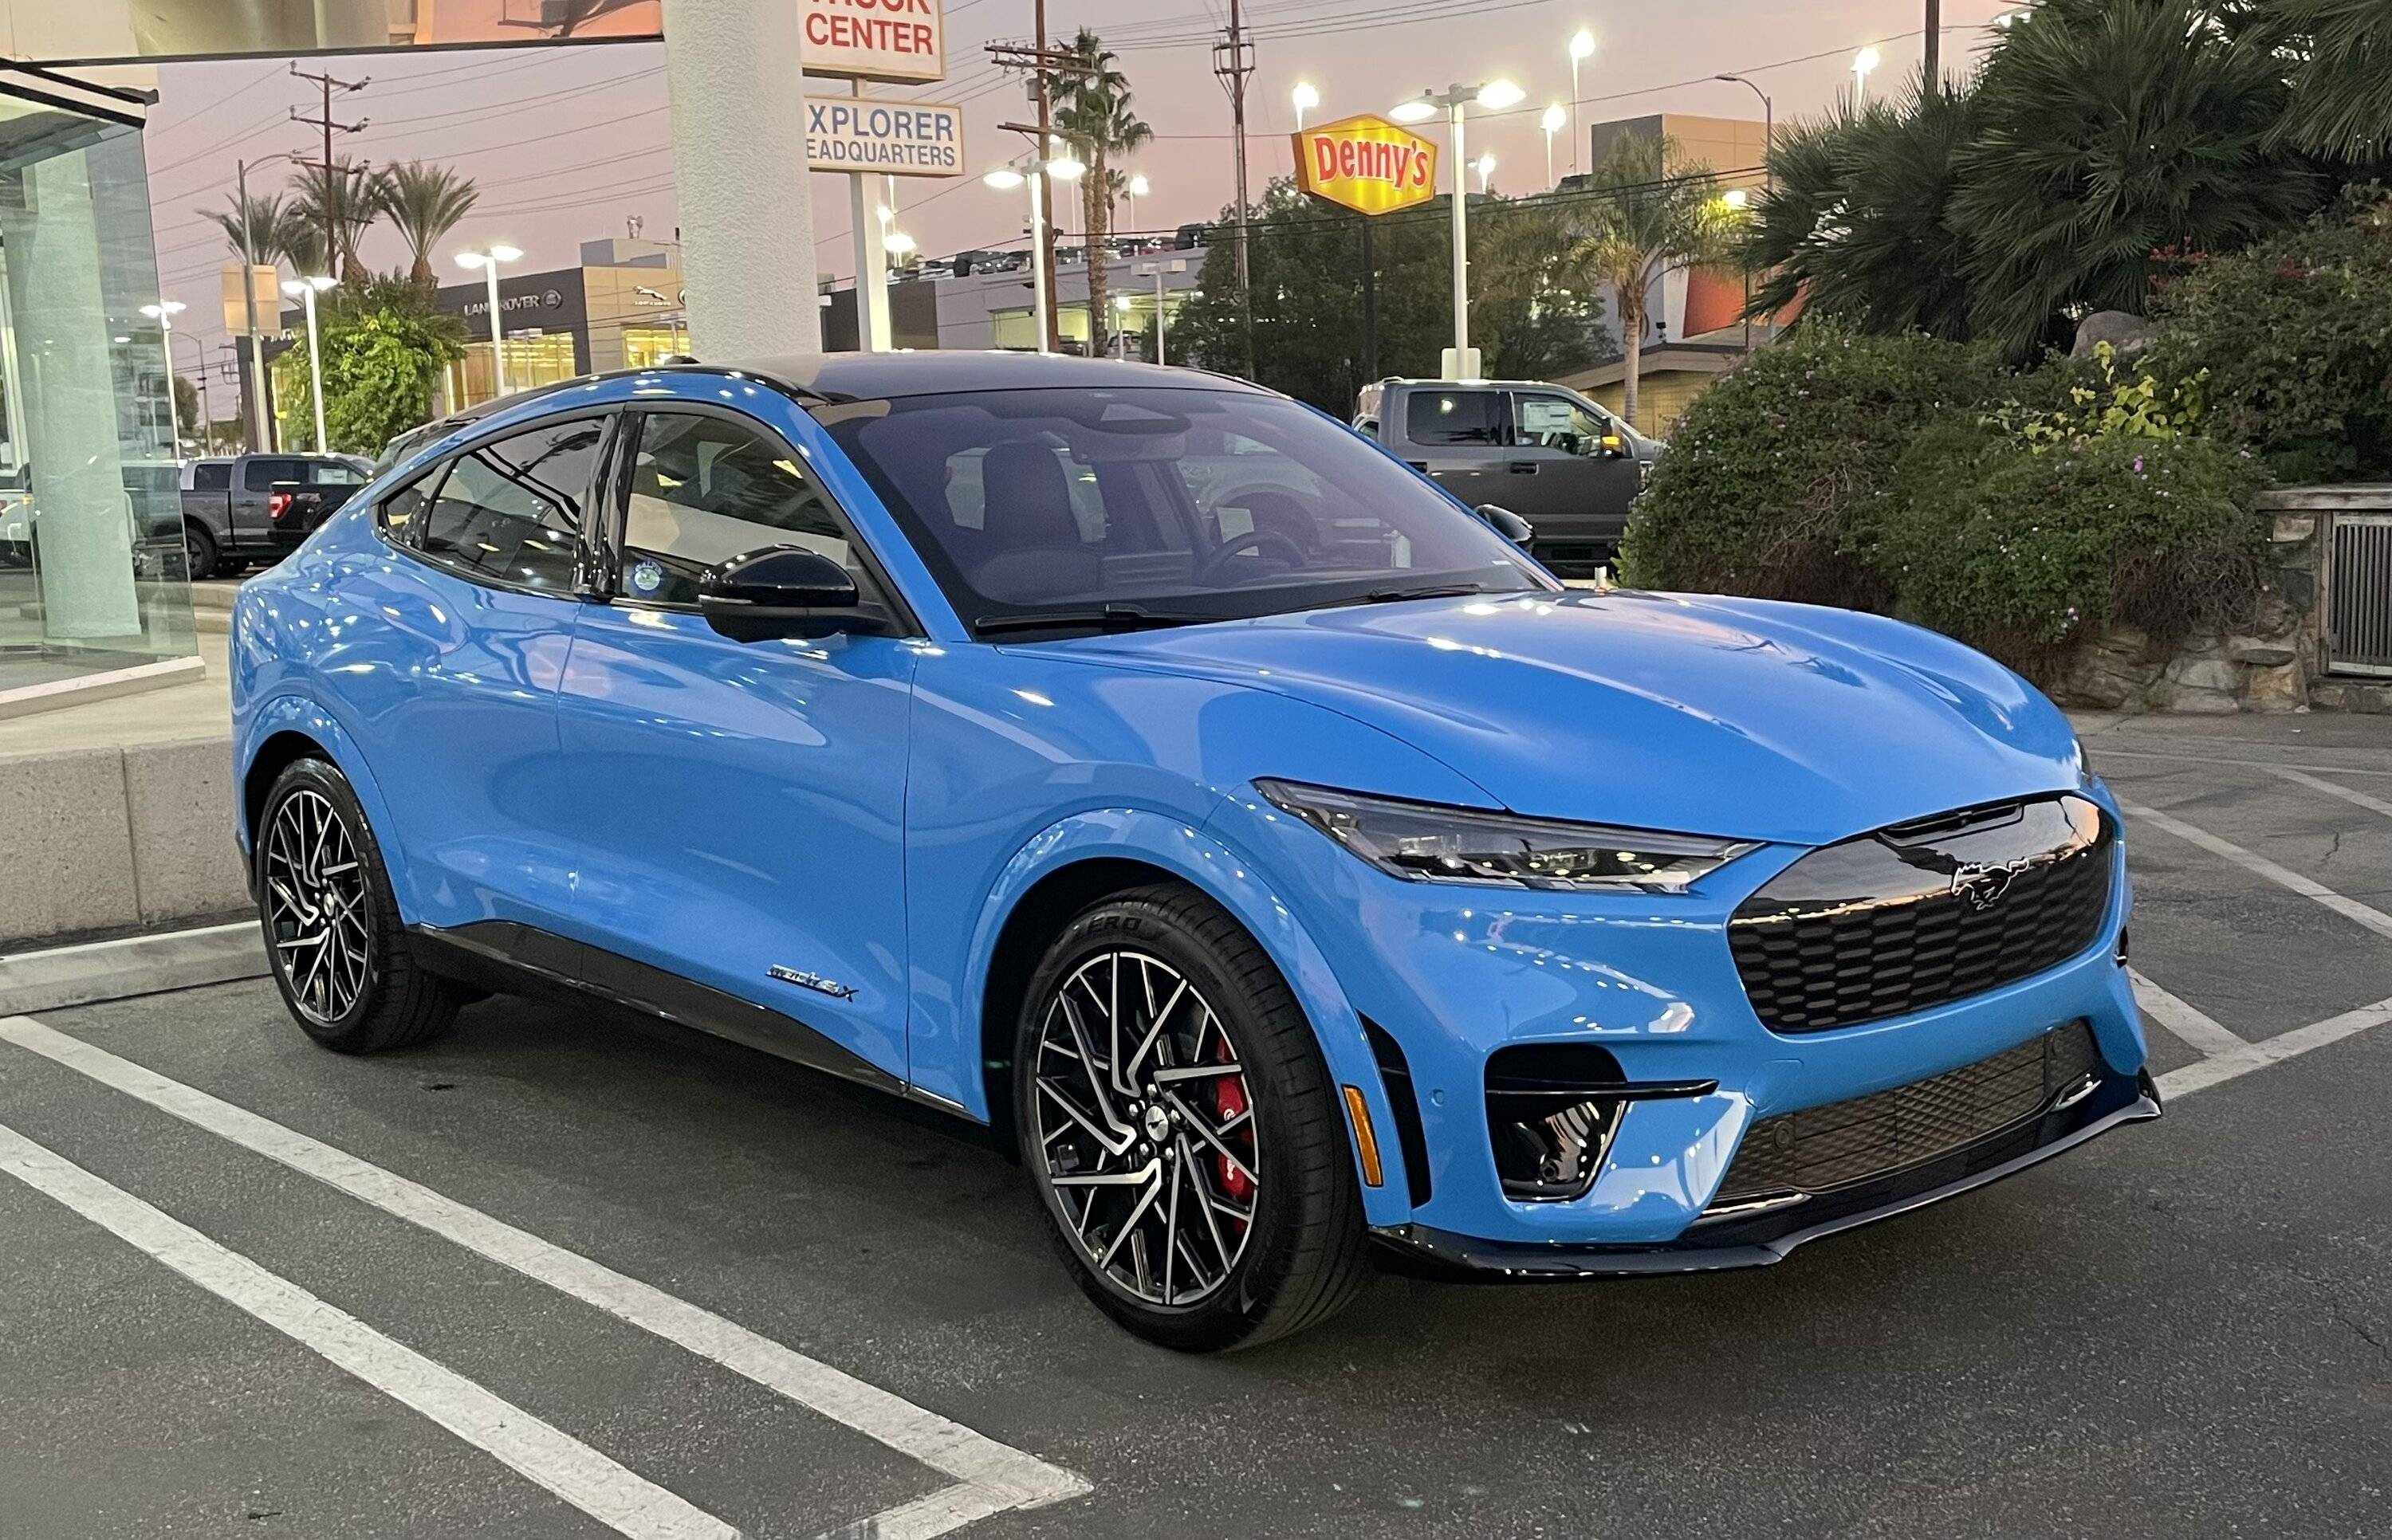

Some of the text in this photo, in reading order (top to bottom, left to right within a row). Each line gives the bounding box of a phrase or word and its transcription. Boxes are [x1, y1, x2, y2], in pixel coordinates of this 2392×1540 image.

[806, 12, 933, 55] CENTER
[808, 104, 954, 142] XPLORER
[806, 138, 955, 167] EADQUARTERS
[1314, 136, 1428, 188] Denny's
[464, 302, 490, 316] LAN
[1081, 915, 1143, 935] ERO
